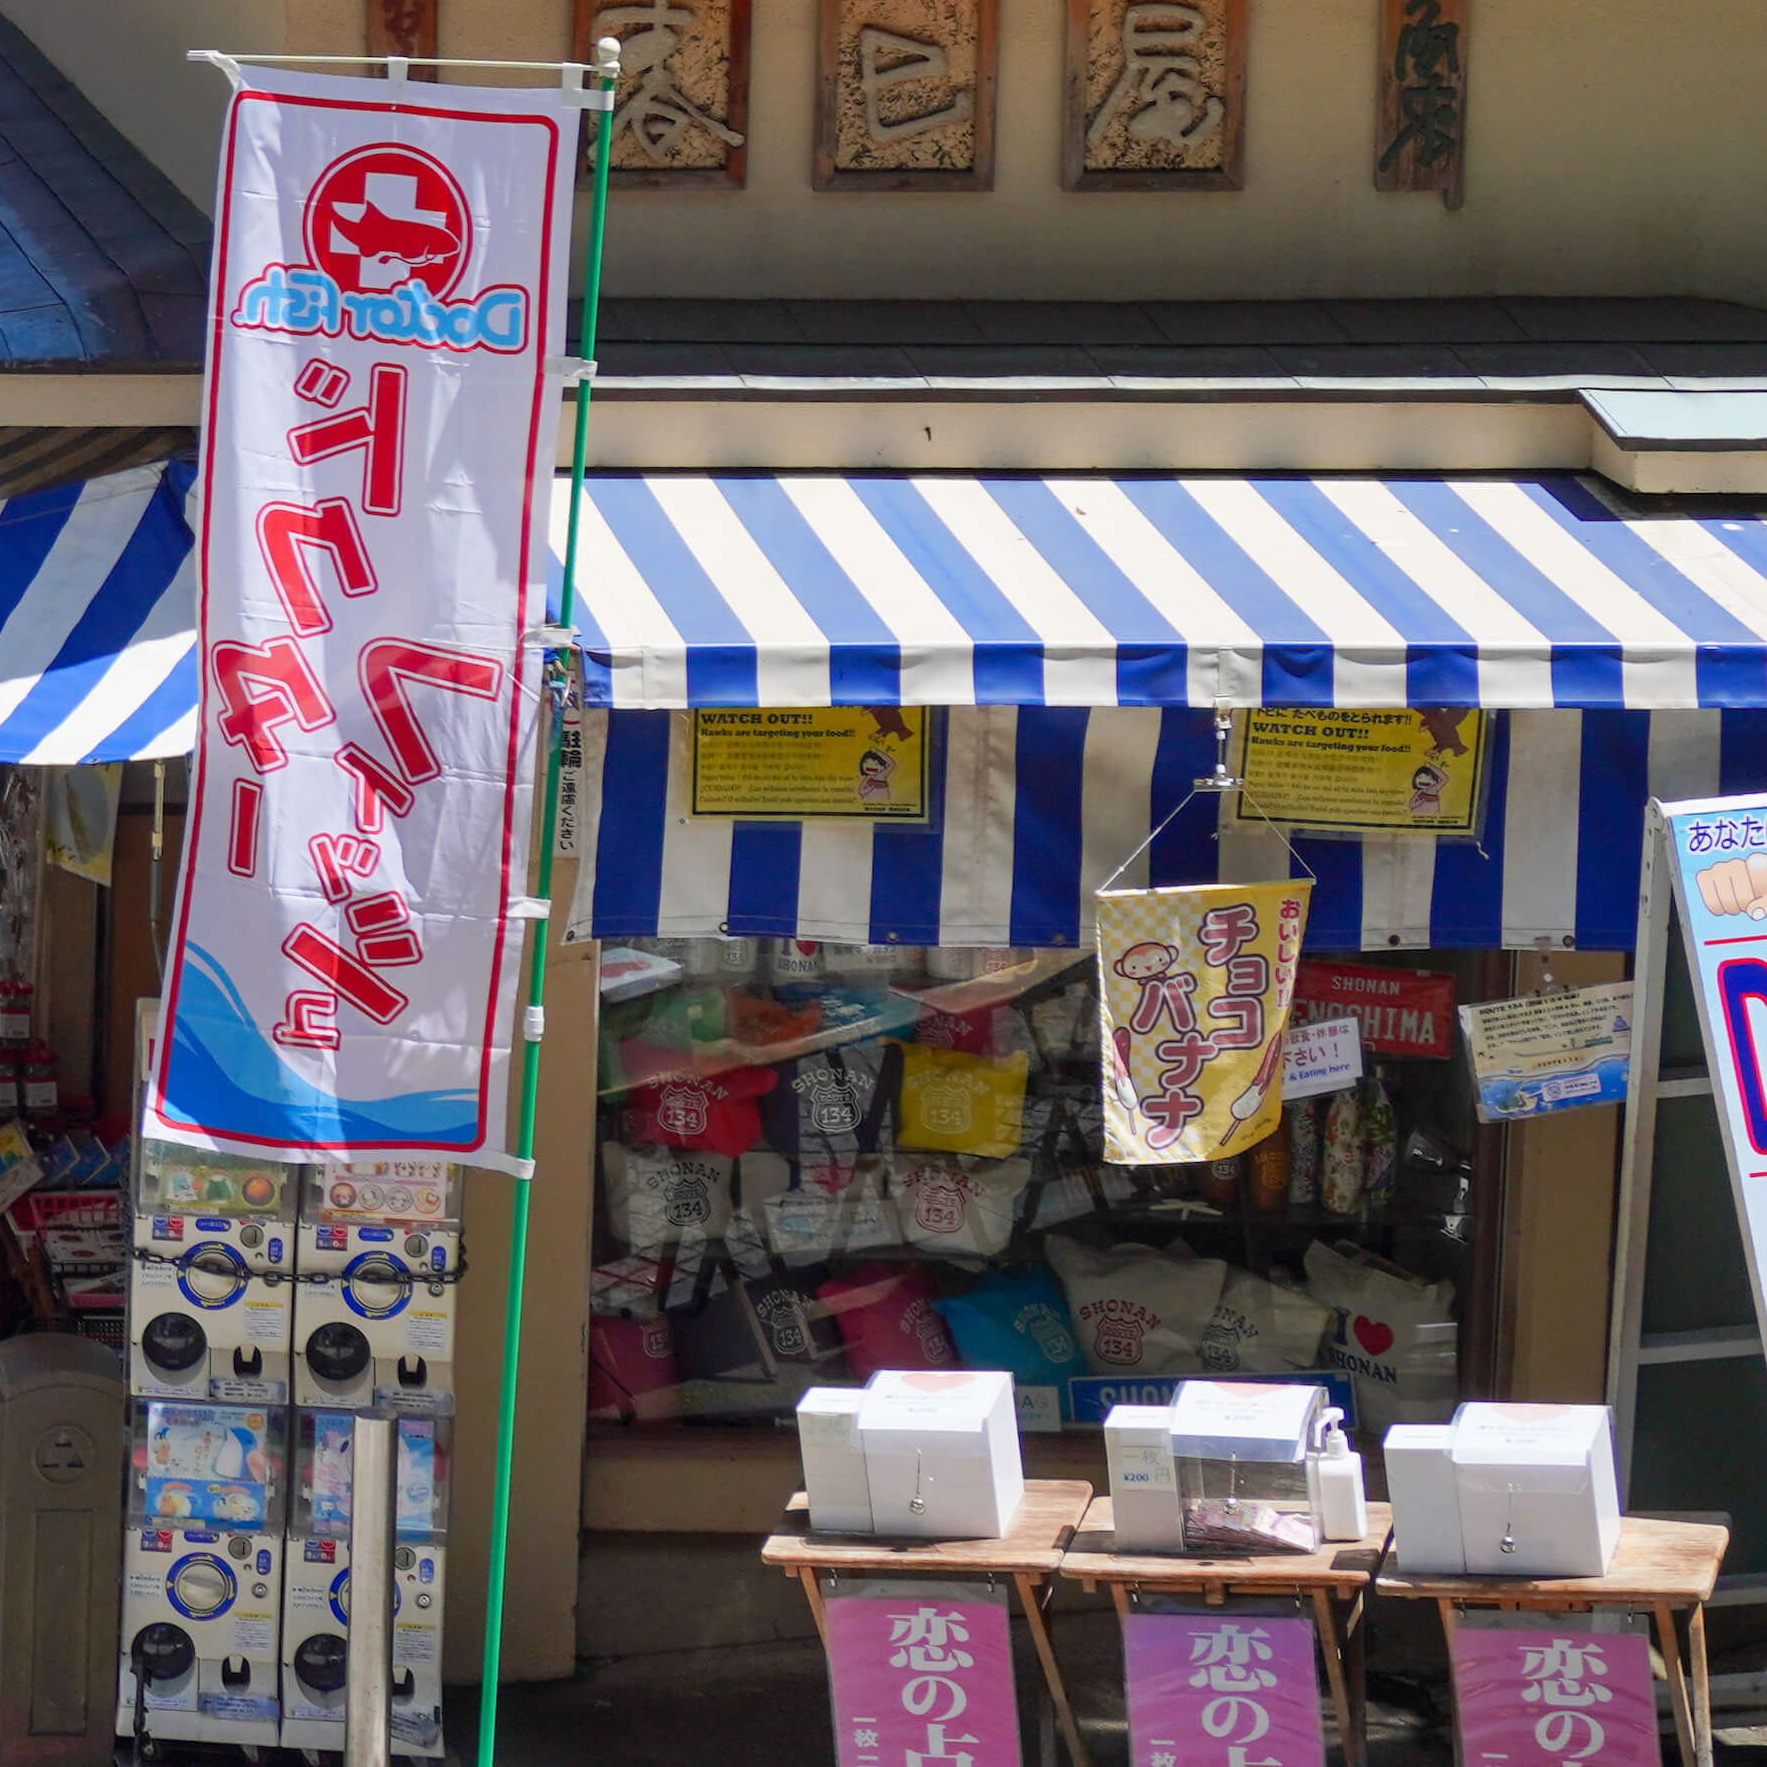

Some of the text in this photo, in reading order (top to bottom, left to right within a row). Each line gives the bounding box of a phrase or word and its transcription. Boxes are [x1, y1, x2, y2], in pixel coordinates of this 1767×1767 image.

[701, 713, 813, 724] WATCH OUT!!
[736, 730, 750, 738] are
[753, 728, 798, 739] targeting
[801, 730, 824, 739] your
[1252, 722, 1369, 739] WATCH OUT!!
[1287, 739, 1302, 747] are
[1305, 739, 1354, 752] targeting
[1356, 743, 1378, 753] your
[1198, 903, 1270, 1050] チョコ
[1331, 975, 1401, 995] SHONAN
[1130, 972, 1219, 1150] バナナ
[792, 1067, 876, 1093] SHONAN
[1299, 1067, 1328, 1079] Eating
[1329, 1063, 1350, 1074] here
[667, 1109, 698, 1128] 134
[821, 1107, 854, 1124] 134
[673, 1199, 703, 1219] 134
[925, 1207, 956, 1224] 134
[1078, 1298, 1162, 1330] SHONAN
[1103, 1341, 1134, 1358] 134
[1328, 1347, 1397, 1384] SHONAN
[1123, 1472, 1149, 1483] ¥200
[1517, 1638, 1614, 1767] 恋の
